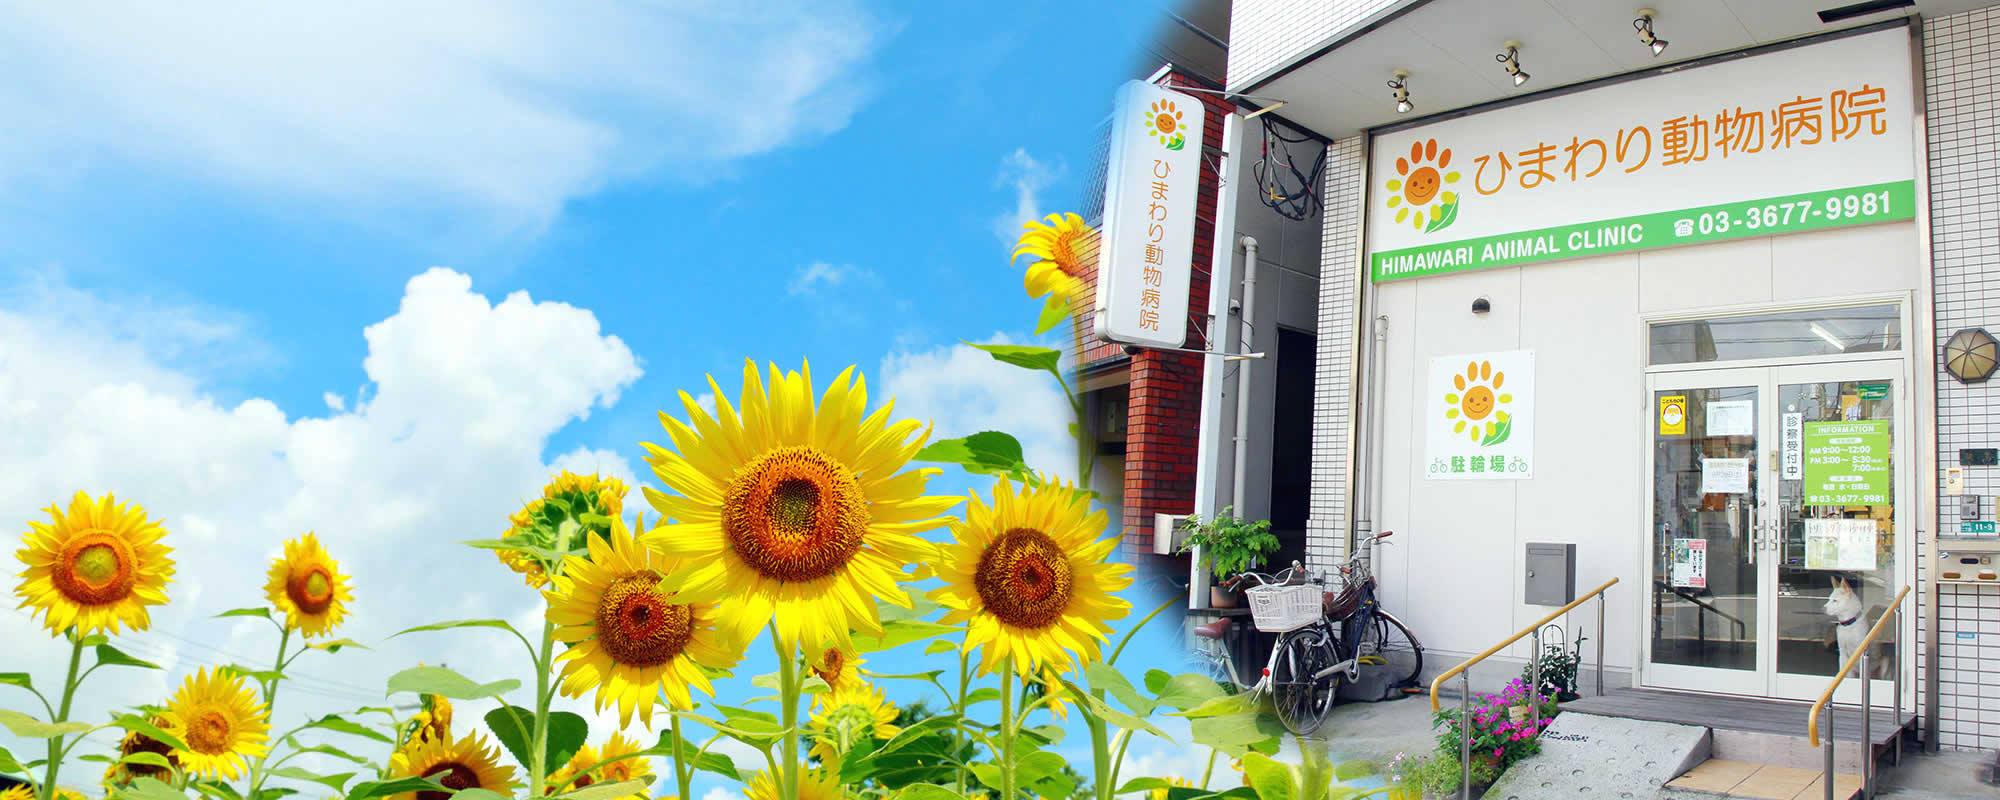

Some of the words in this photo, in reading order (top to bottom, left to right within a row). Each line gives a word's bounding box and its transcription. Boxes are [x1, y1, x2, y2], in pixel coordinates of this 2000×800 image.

[1474, 84, 1887, 196] ひまわり動物病院
[1698, 190, 1891, 235] 03-3677-9981
[1139, 159, 1171, 332] ひまわり動物病院
[1381, 246, 1474, 276] HIMAWARI
[1481, 233, 1560, 263] ANIMAL
[1568, 223, 1644, 252] CLINIC
[1451, 455, 1505, 473] 駐輪場
[1786, 416, 1798, 476] 診察受付中
[1852, 464, 1871, 472] 7:00
